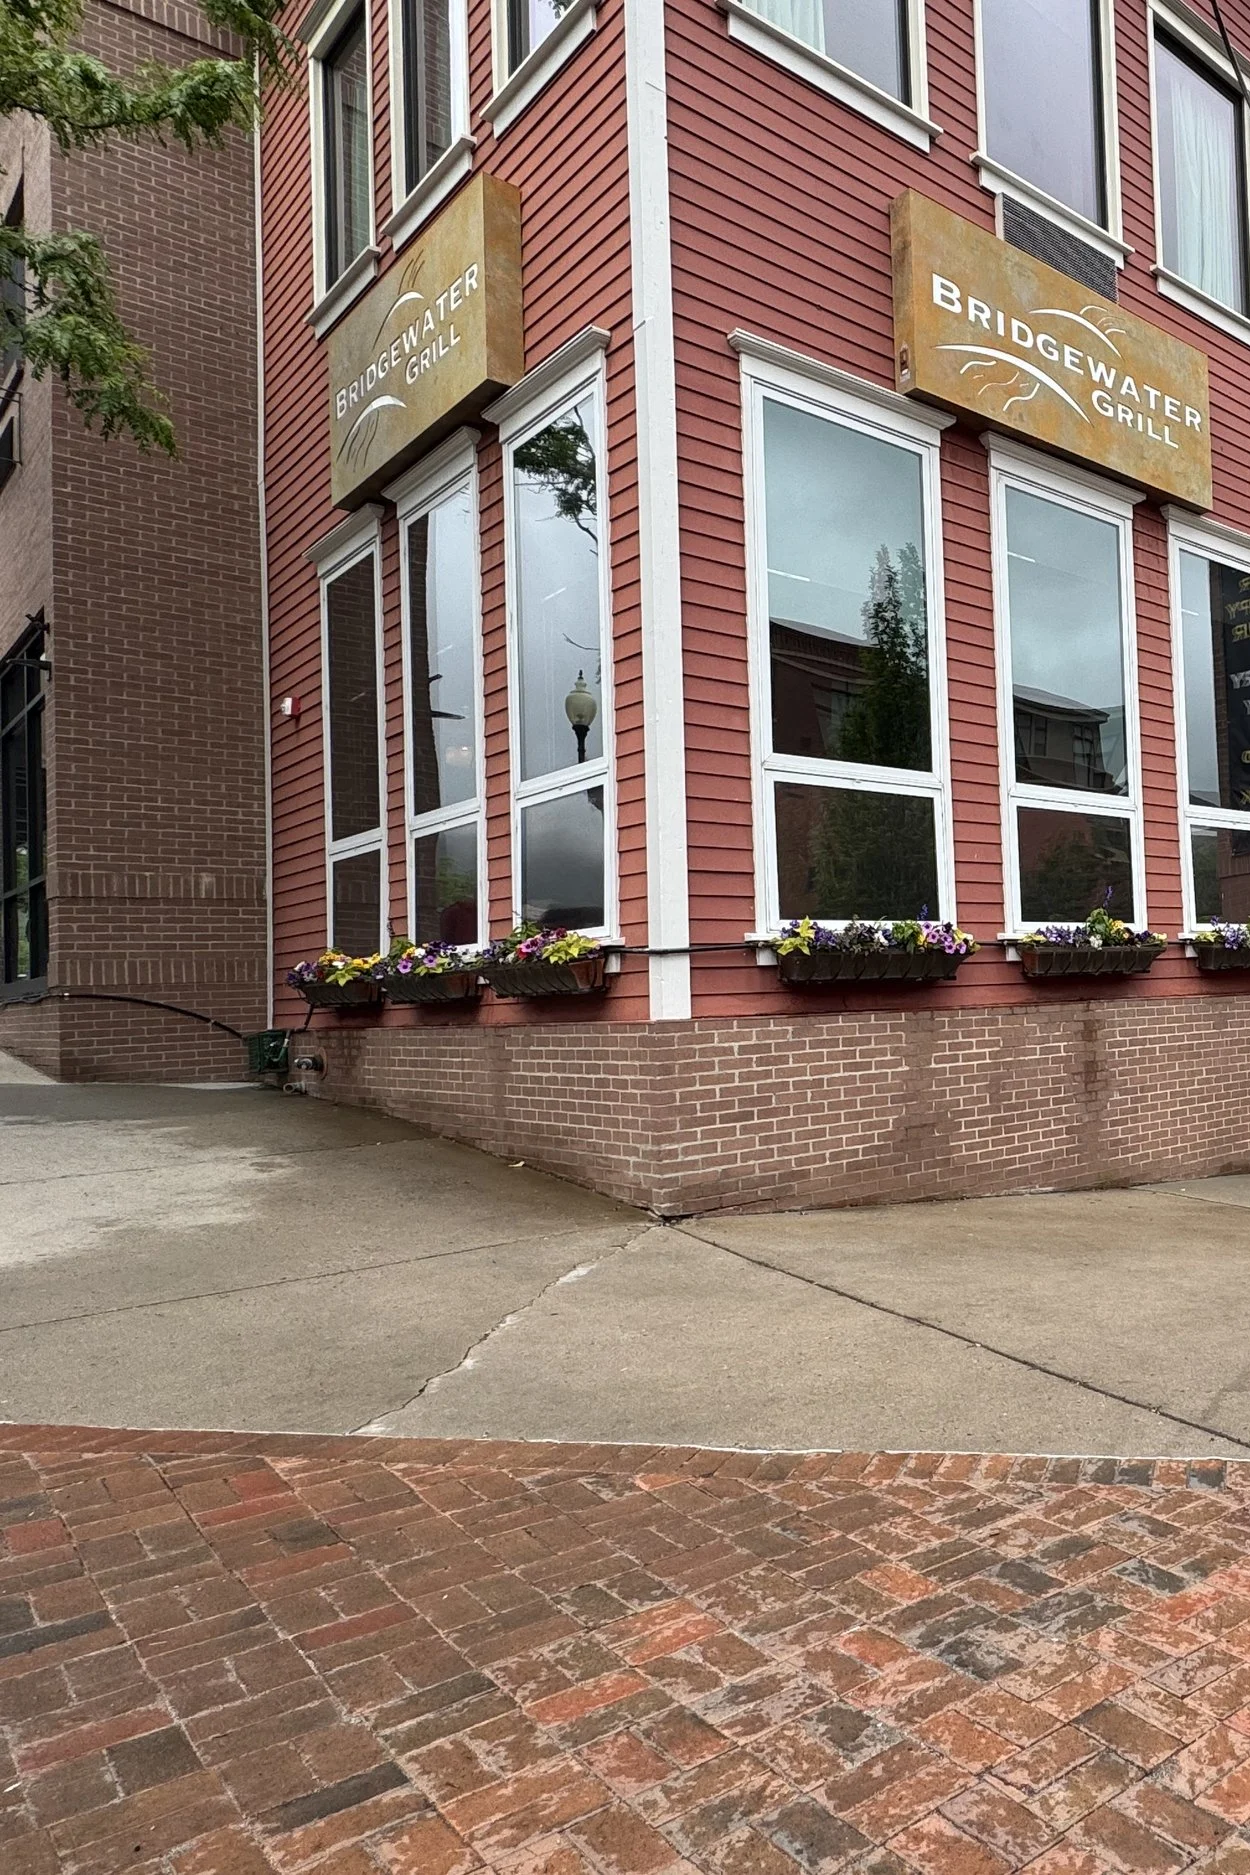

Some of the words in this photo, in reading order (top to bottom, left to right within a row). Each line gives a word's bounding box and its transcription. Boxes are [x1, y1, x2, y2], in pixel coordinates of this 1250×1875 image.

[335, 262, 479, 420] BRIDGEWATER
[404, 323, 461, 386] GRILL
[932, 272, 1202, 432] BRIDGEWATER
[1091, 389, 1179, 450] GRILL
